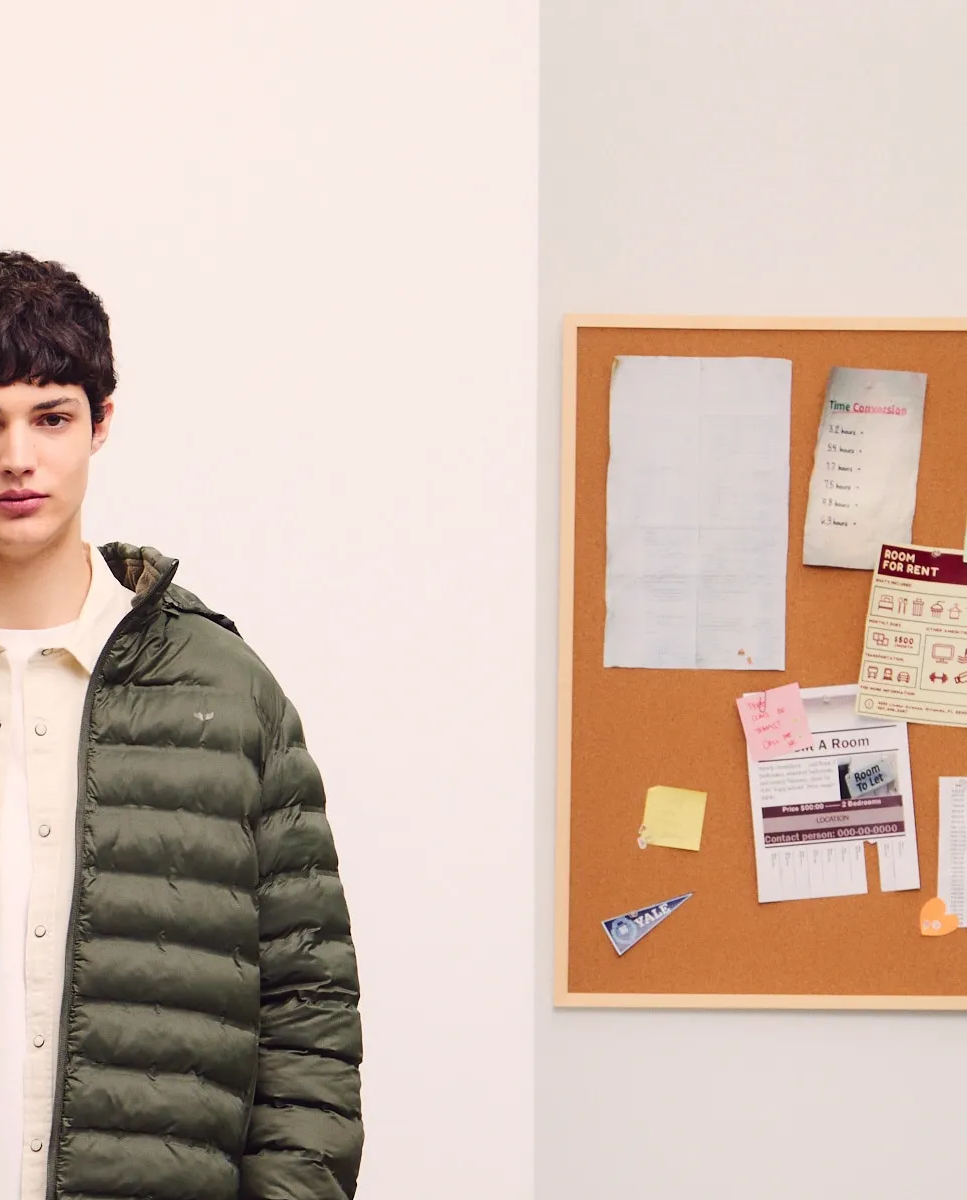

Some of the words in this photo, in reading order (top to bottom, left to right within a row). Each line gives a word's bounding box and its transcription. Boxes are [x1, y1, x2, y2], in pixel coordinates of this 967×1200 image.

[830, 400, 850, 411] Time
[853, 402, 907, 415] Conversion
[841, 427, 856, 435] hours
[839, 445, 854, 453] hours
[838, 464, 852, 472] hours
[835, 482, 851, 490] hours
[834, 500, 850, 508] hours
[832, 518, 848, 527] hours
[884, 549, 915, 563] ROOM
[882, 560, 904, 572] FOR
[906, 563, 939, 577] RENT
[894, 636, 914, 645] $500
[818, 739, 827, 750] A
[832, 737, 870, 749] Room
[854, 764, 881, 783] Room
[856, 781, 868, 793] To
[869, 773, 884, 787] Let
[782, 804, 800, 813] Price
[847, 798, 882, 808] Bedrooms
[816, 814, 850, 824] LOCATION
[764, 832, 800, 844] Contact
[802, 830, 835, 842] person:
[837, 824, 898, 837] 000-00-0000
[634, 903, 671, 928] YALE
